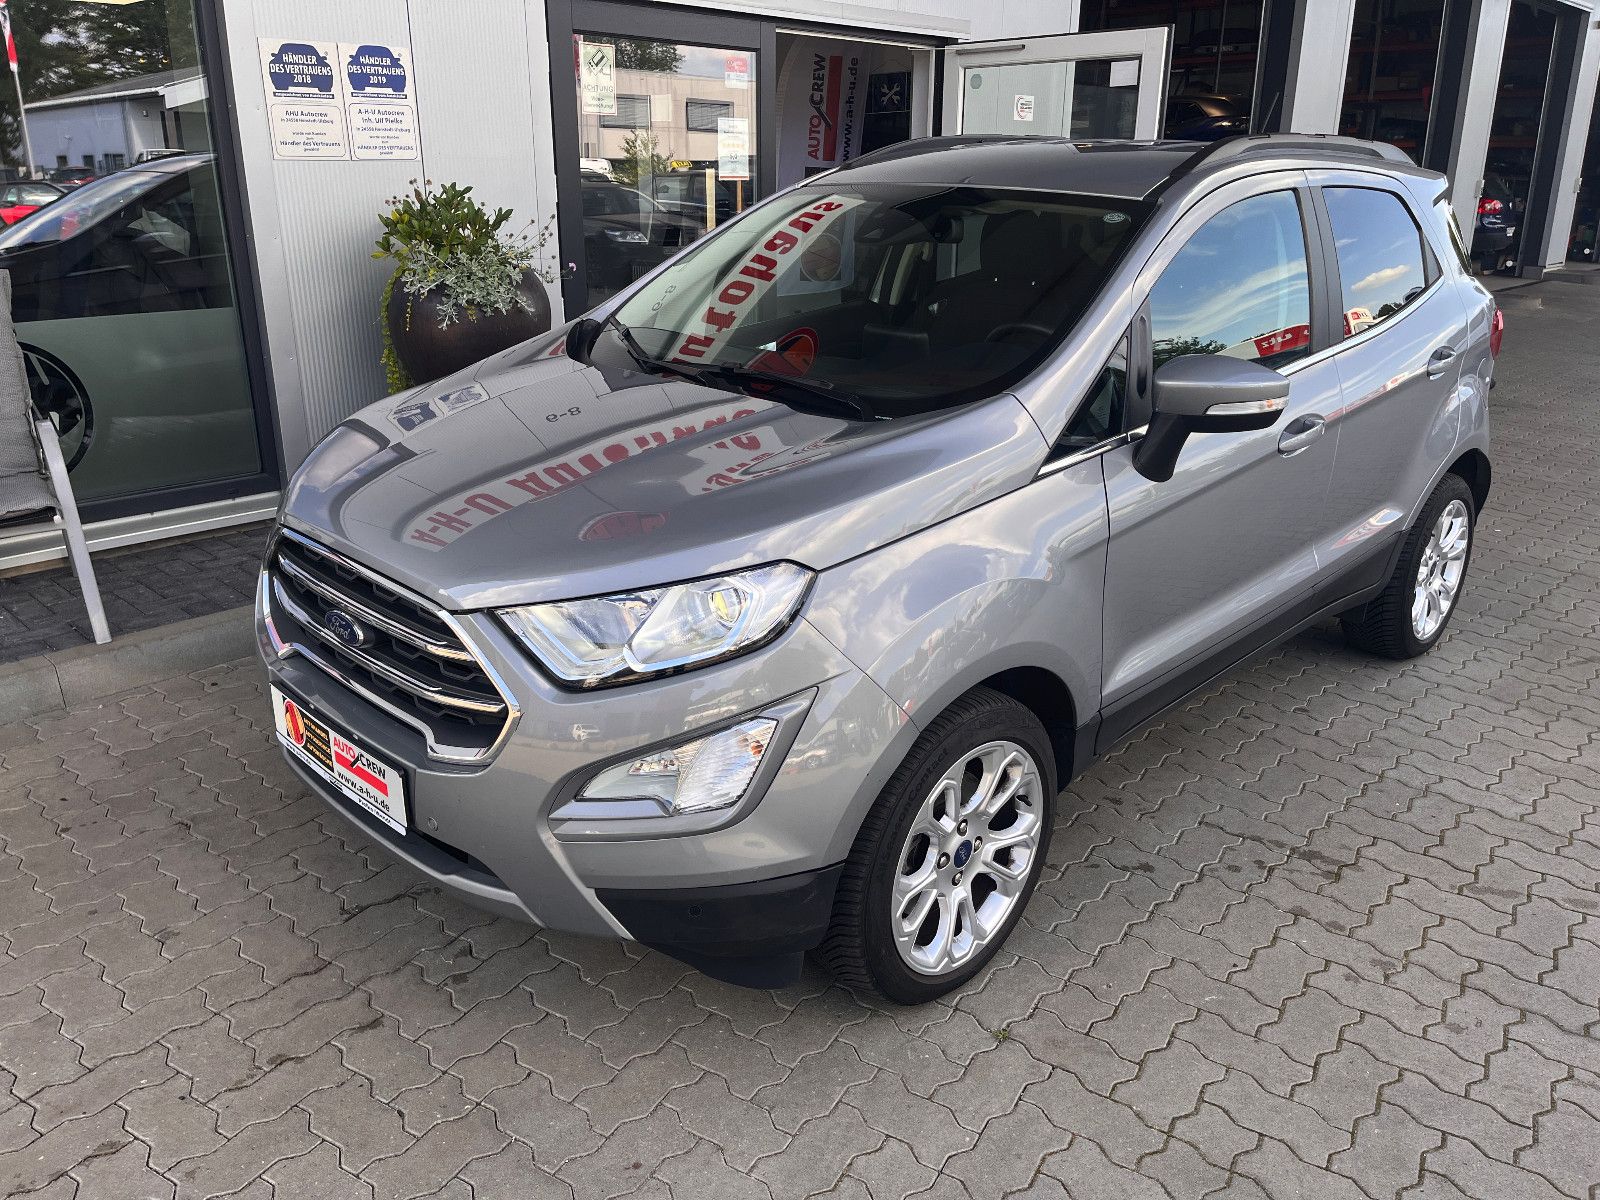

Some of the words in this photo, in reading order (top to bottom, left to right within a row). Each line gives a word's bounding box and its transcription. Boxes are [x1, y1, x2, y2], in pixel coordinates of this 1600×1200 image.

[282, 51, 318, 65] HÄNDLER
[360, 54, 392, 66] HÄNDLER
[269, 63, 285, 73] DES
[285, 64, 332, 76] VERTRAUENS
[347, 64, 362, 74] DES
[362, 65, 405, 76] VERTRAUENS
[293, 74, 312, 84] 2018
[369, 75, 387, 84] 2019
[300, 110, 328, 118] Autocrew
[842, 57, 859, 161] www.a-h-u.de
[808, 114, 822, 160] AUTO
[329, 615, 351, 640] Ford
[333, 736, 356, 758] AUTO
[357, 751, 387, 780] CREW
[336, 770, 390, 813] www.a-h-u.de
